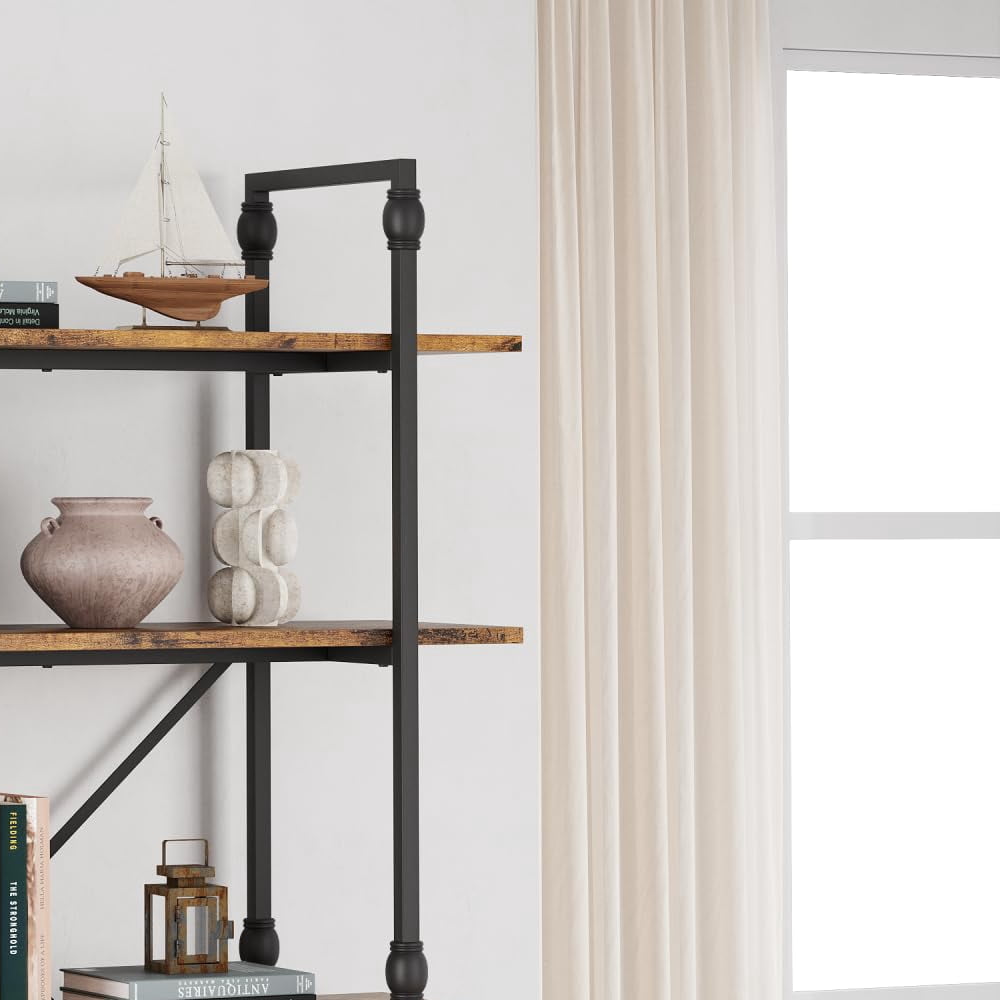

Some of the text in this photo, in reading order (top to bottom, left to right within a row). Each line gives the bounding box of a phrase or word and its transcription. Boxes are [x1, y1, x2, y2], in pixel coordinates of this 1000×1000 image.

[15, 308, 40, 316] Virginia
[21, 318, 41, 326] Detail
[9, 882, 17, 955] THE STRONGHOLD
[178, 982, 270, 998] ANTIQUAIRES
